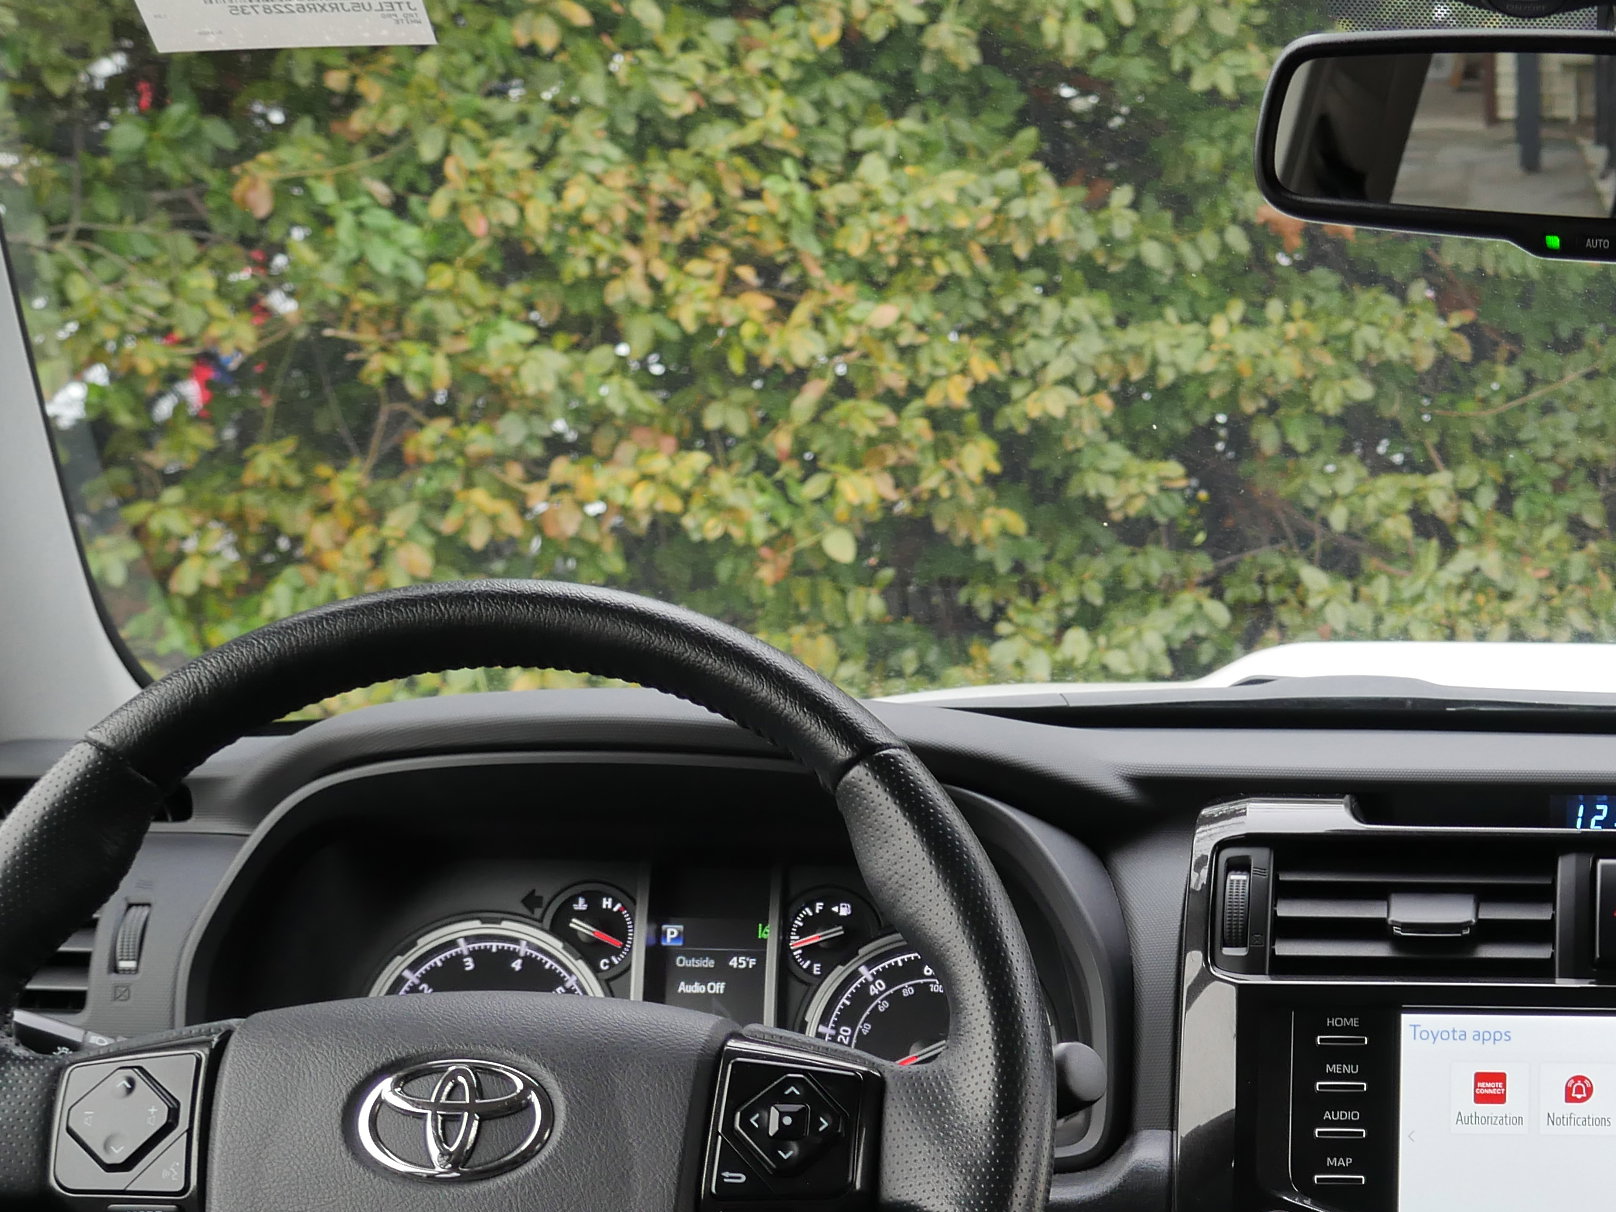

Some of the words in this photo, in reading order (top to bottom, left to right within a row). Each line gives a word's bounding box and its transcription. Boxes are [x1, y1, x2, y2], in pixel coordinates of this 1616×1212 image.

[1585, 238, 1610, 249] AUTO
[602, 898, 612, 909] H
[815, 902, 824, 914] F
[463, 957, 475, 972] 3
[511, 958, 523, 972] 4
[600, 959, 610, 970] C
[675, 956, 715, 968] Outside
[812, 963, 822, 975] E
[677, 981, 706, 994] Audio
[707, 982, 726, 994] Off
[869, 979, 887, 997] 40
[902, 986, 915, 998] 80
[877, 1000, 890, 1013] 60
[1326, 1017, 1360, 1028] HOME
[860, 1022, 872, 1036] 40
[1408, 1023, 1467, 1045] Toyota
[1471, 1028, 1512, 1045] apps
[837, 1026, 852, 1045] 20
[1325, 1064, 1359, 1074] MENU
[1323, 1110, 1360, 1121] AUDIO
[1455, 1111, 1524, 1126] Authorization
[1546, 1112, 1612, 1127] Notifications
[1326, 1157, 1353, 1167] MAP
